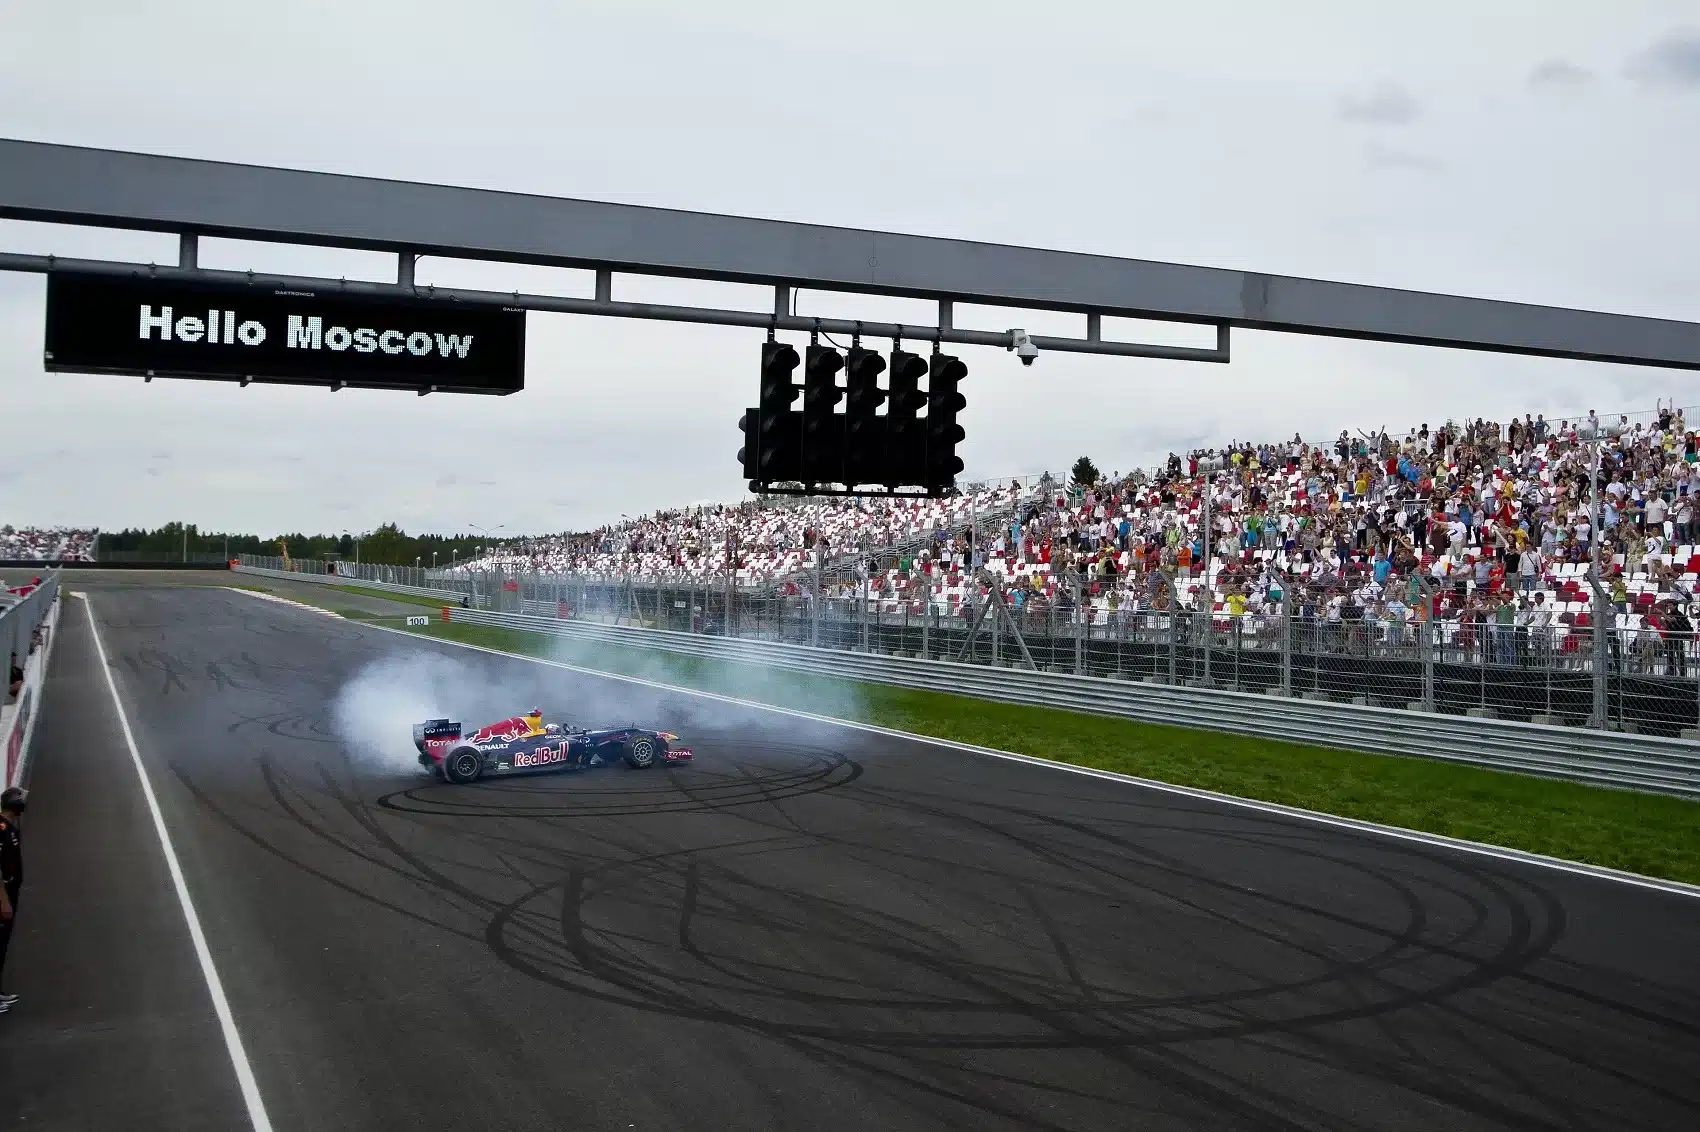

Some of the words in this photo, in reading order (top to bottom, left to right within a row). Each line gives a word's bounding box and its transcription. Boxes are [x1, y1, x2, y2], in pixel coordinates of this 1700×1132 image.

[140, 305, 266, 345] Hello
[287, 315, 474, 358] Moscow
[409, 617, 425, 626] 100
